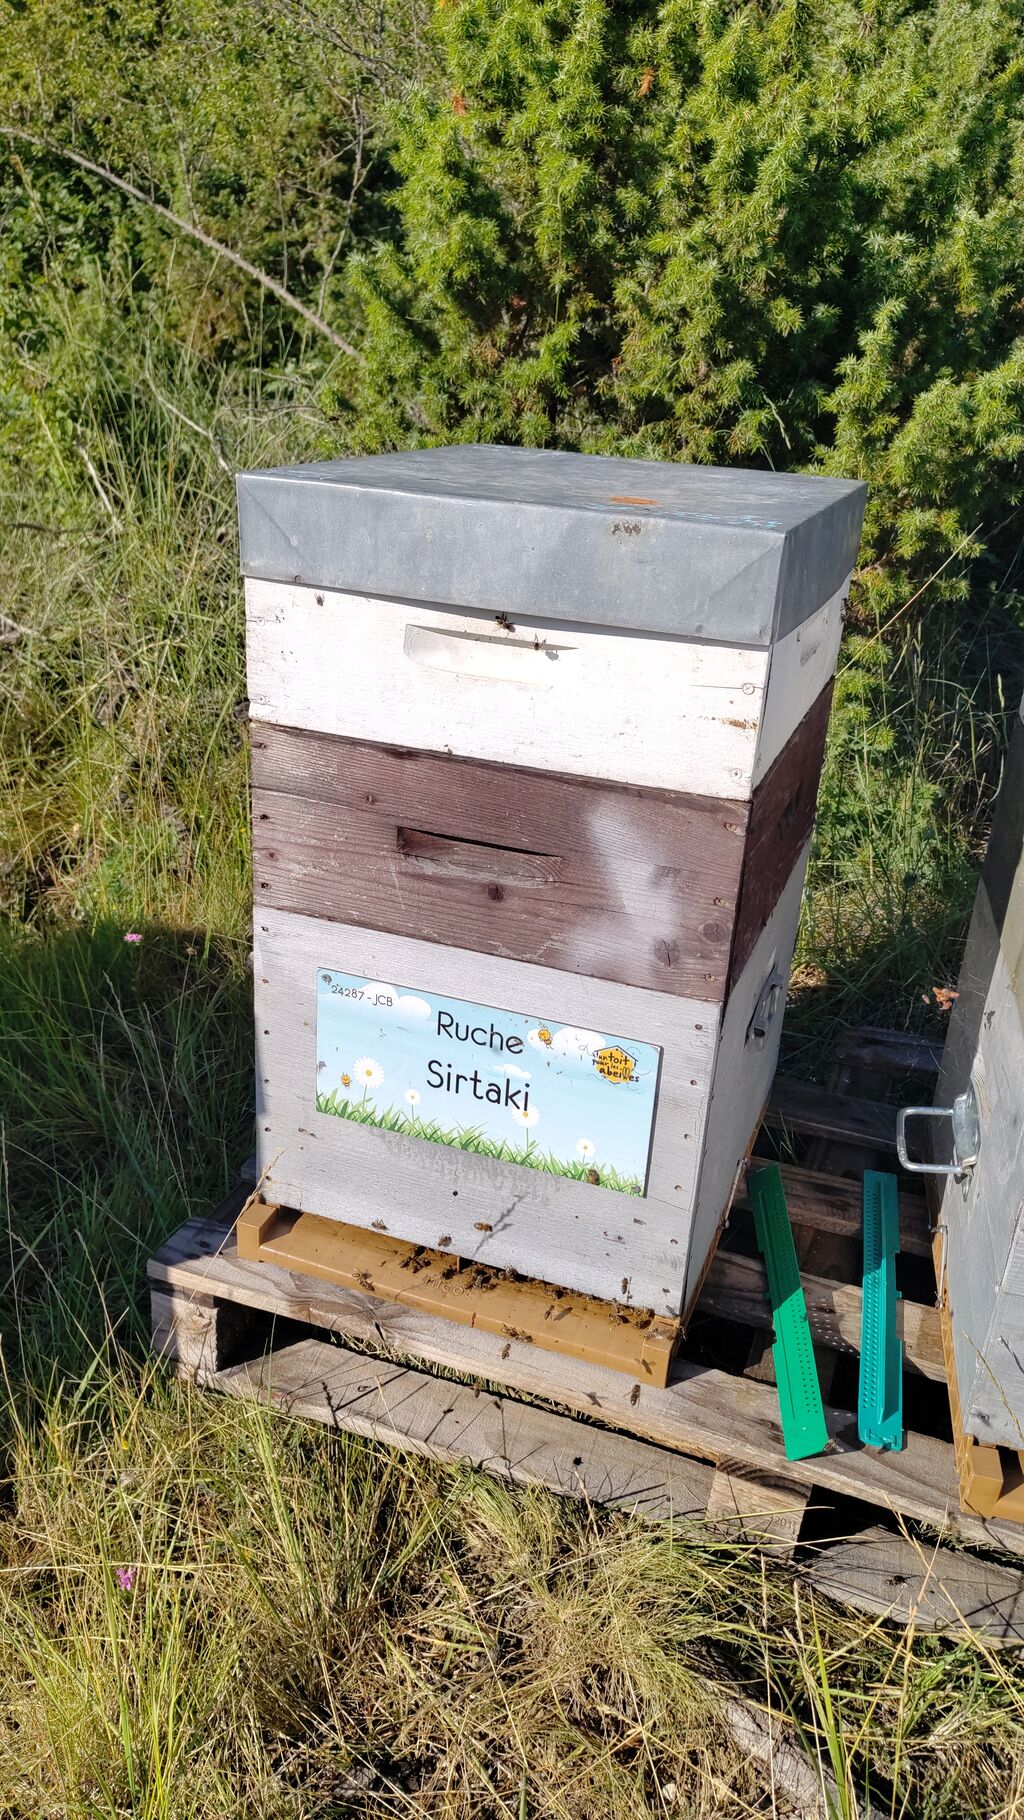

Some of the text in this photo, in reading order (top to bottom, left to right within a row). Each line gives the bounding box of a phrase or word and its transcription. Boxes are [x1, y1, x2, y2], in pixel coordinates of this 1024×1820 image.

[331, 984, 365, 1001] 24287
[372, 993, 394, 1007] JCB
[437, 1010, 524, 1055] Ruche
[608, 1051, 630, 1066] toit
[426, 1059, 530, 1112] Sirtaki
[599, 1065, 640, 1083] abeilles
